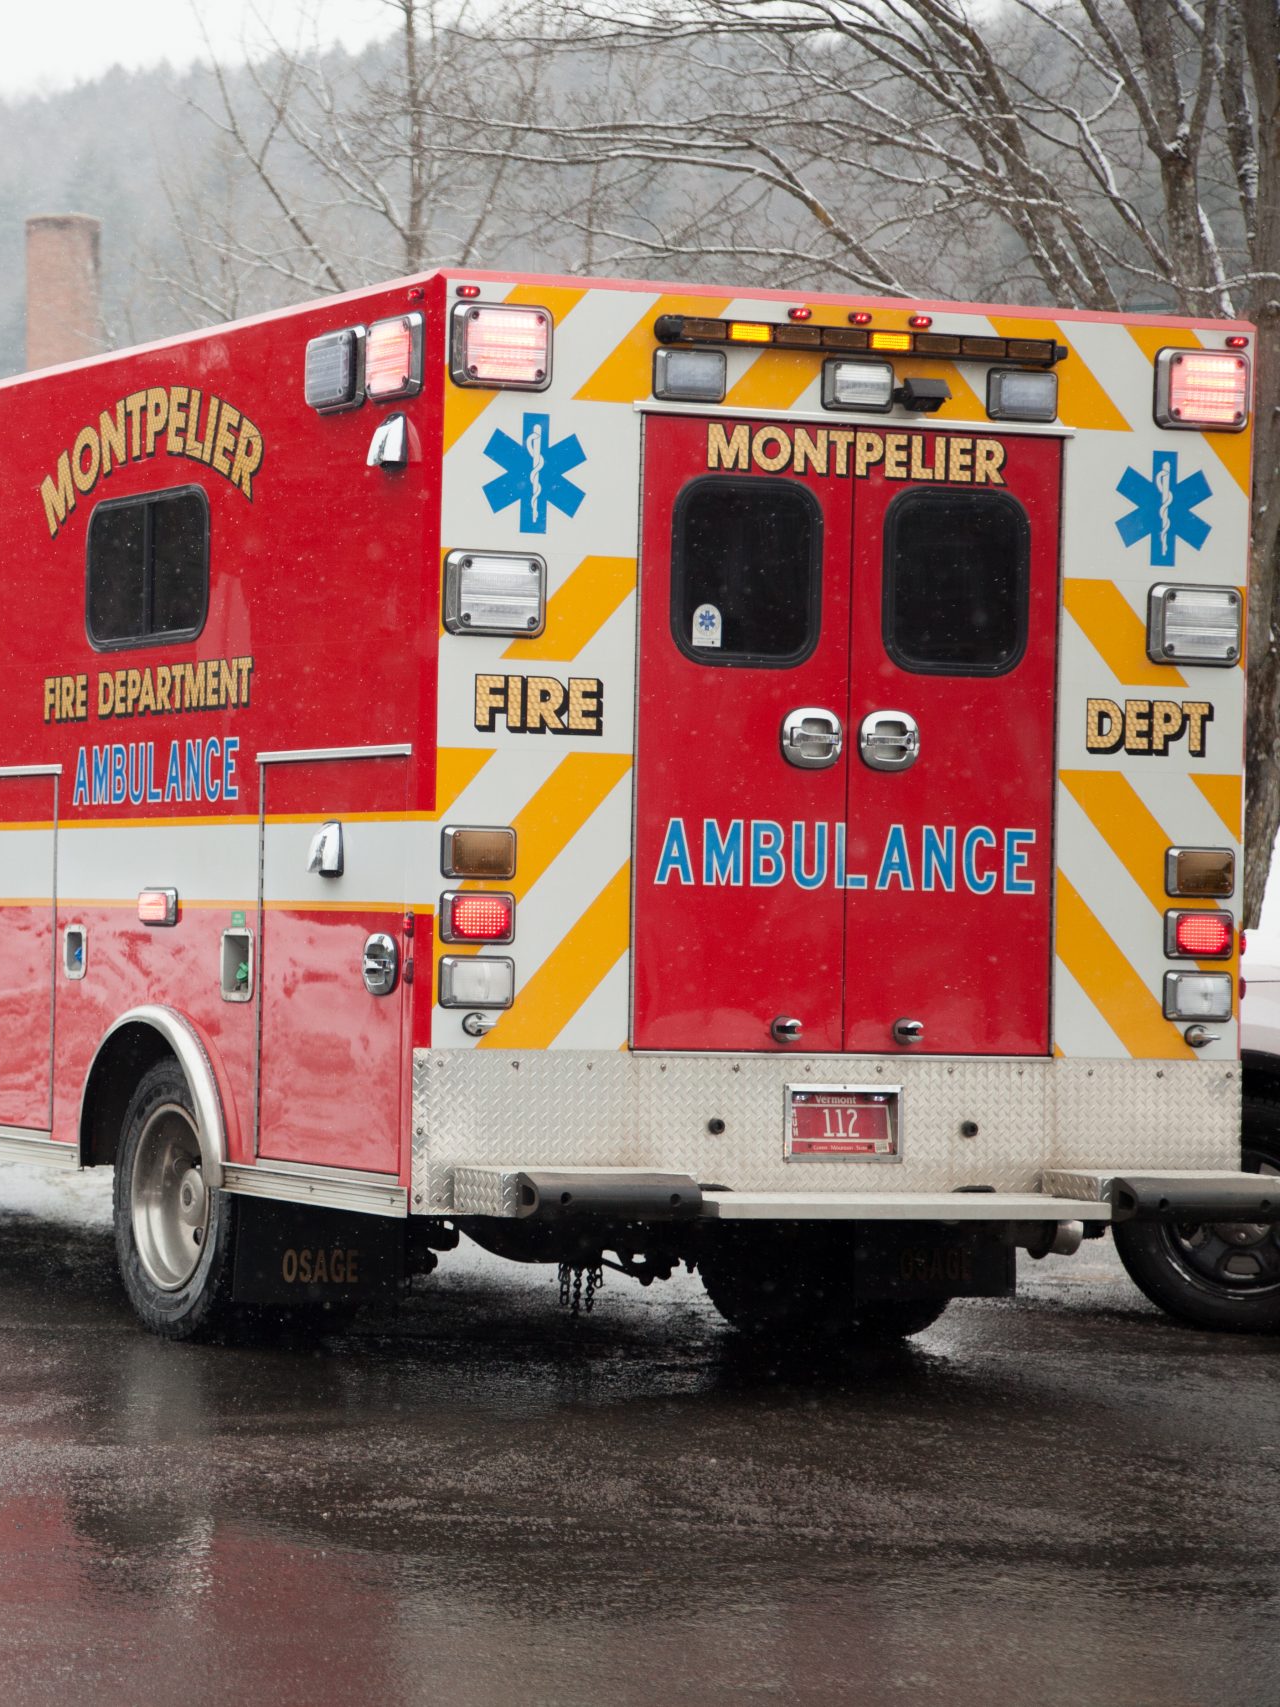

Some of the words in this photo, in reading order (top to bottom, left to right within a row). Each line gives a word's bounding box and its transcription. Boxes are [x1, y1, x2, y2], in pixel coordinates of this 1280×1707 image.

[39, 386, 264, 537] MONTPELIER
[706, 423, 1008, 485] MONTPELIER
[44, 673, 87, 723] FIRE
[97, 657, 253, 721] DEPARTMENT
[474, 673, 604, 736] FIRE
[1085, 698, 1214, 757] DEPT
[72, 737, 240, 806] AMBULANCE
[653, 817, 1038, 896] AMBULANCE
[815, 1095, 857, 1105] Vermont
[822, 1108, 860, 1138] 112
[282, 1247, 360, 1283] OSAGE
